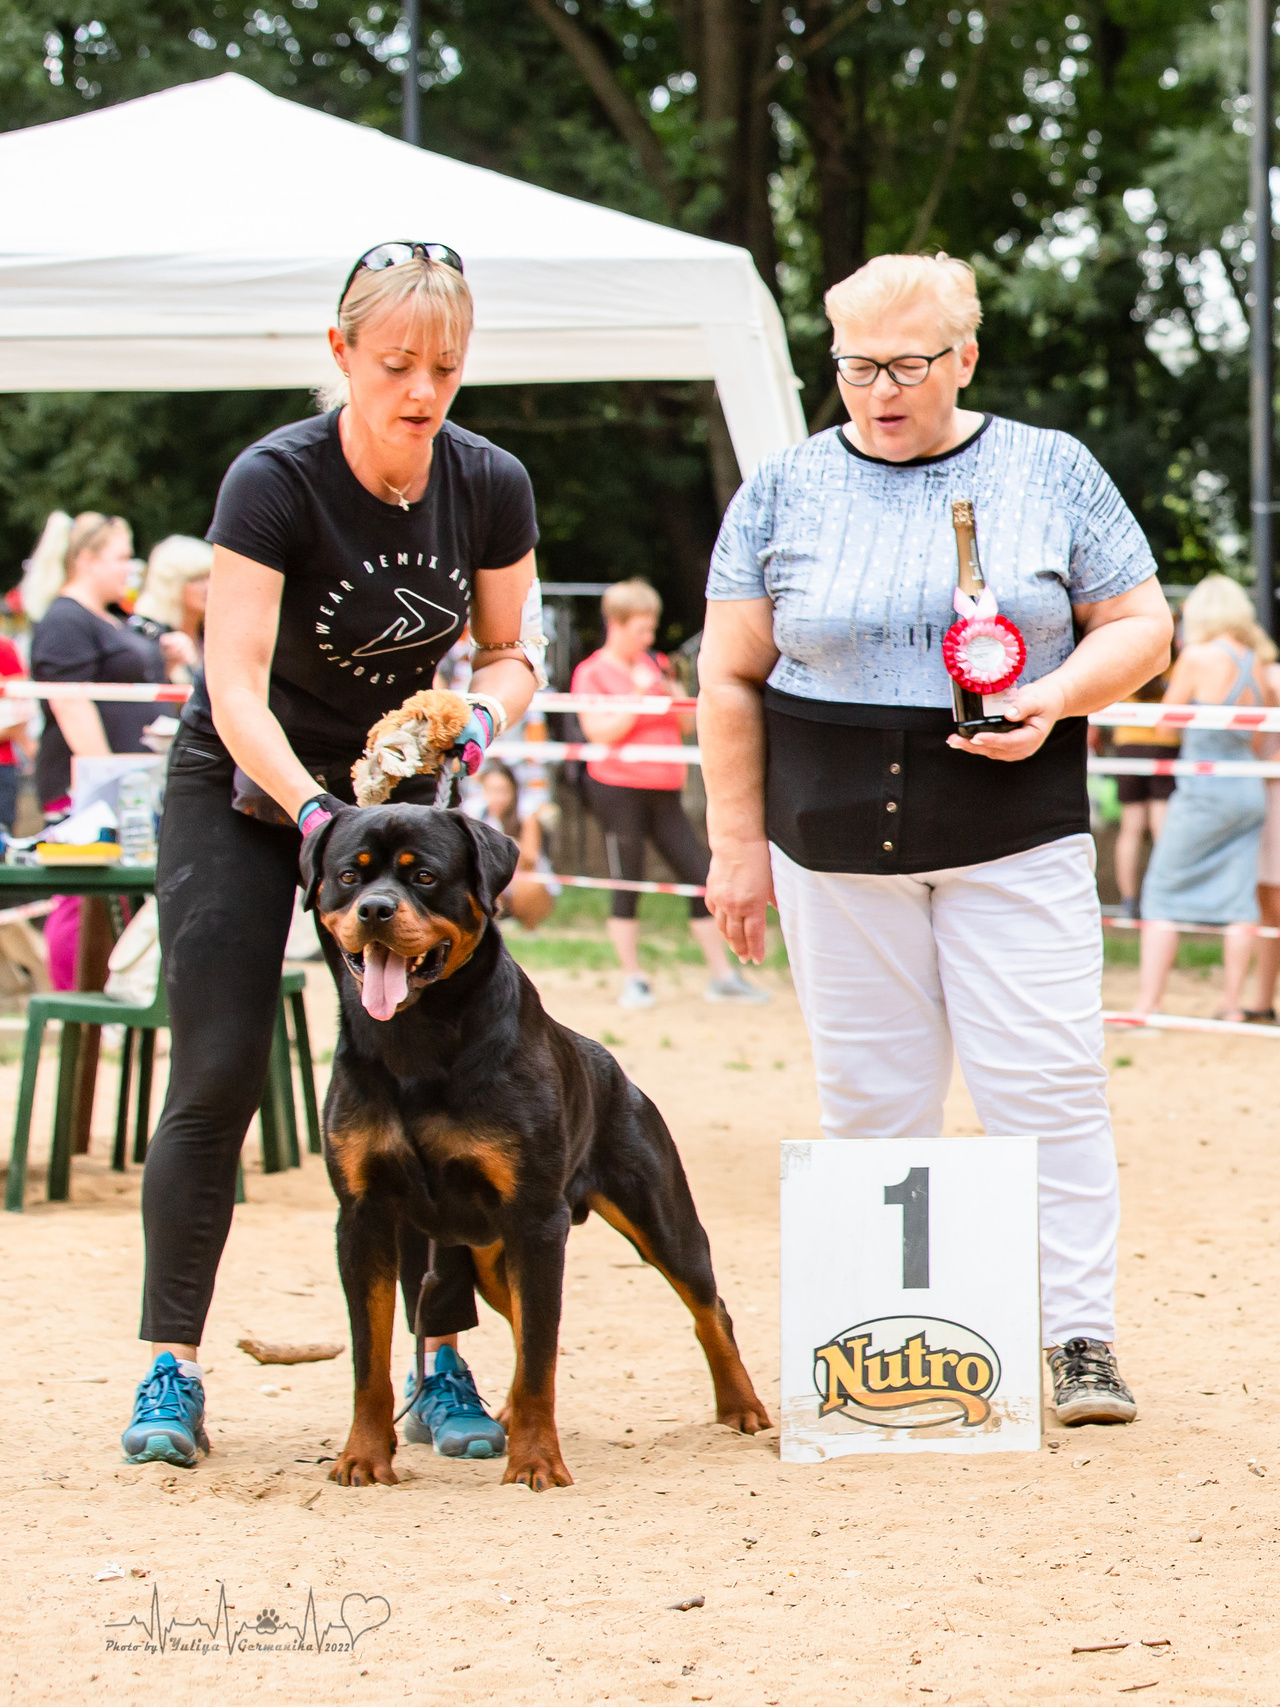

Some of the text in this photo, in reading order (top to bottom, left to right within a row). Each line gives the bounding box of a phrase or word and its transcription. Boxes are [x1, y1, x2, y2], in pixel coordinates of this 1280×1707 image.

[362, 552, 439, 575] DEMIX
[883, 1166, 930, 1289] 1
[813, 1330, 994, 1420] Nutro
